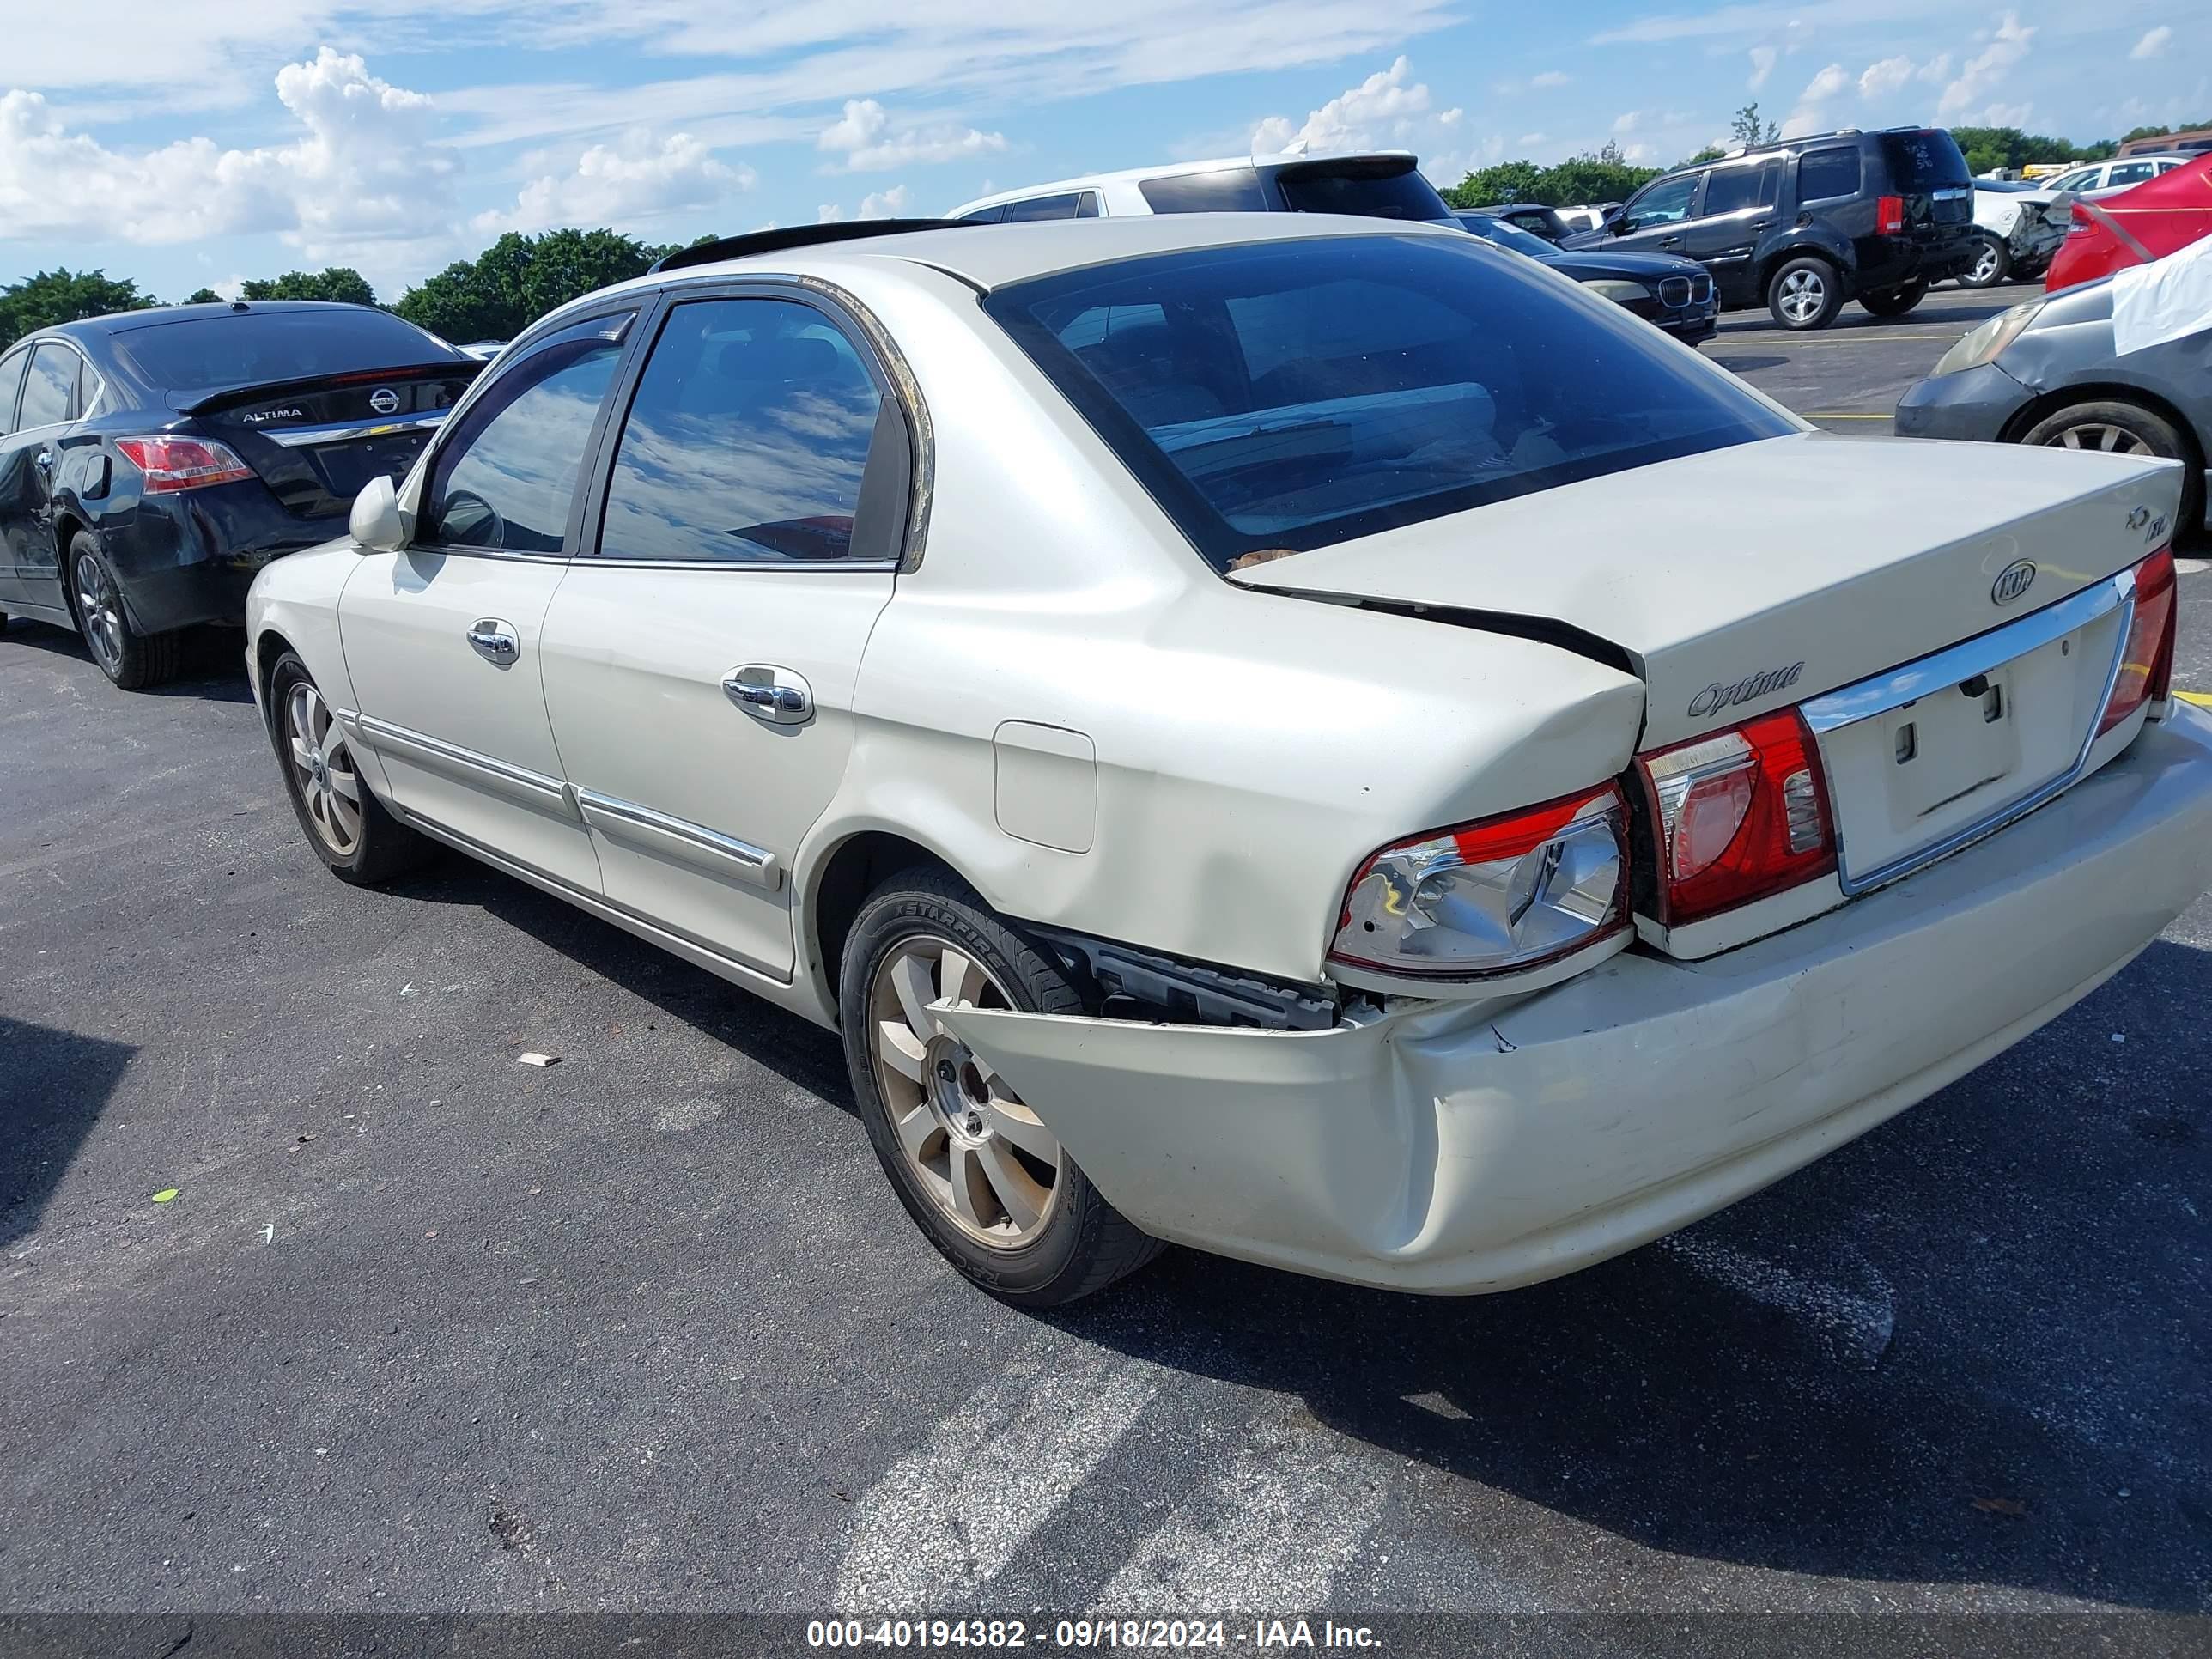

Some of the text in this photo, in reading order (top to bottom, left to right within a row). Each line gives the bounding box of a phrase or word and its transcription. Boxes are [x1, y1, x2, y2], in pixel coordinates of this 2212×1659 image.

[243, 409, 302, 422] ALTIMA
[1688, 661, 1806, 718] Optima
[902, 901, 1010, 969] STARFIRE
